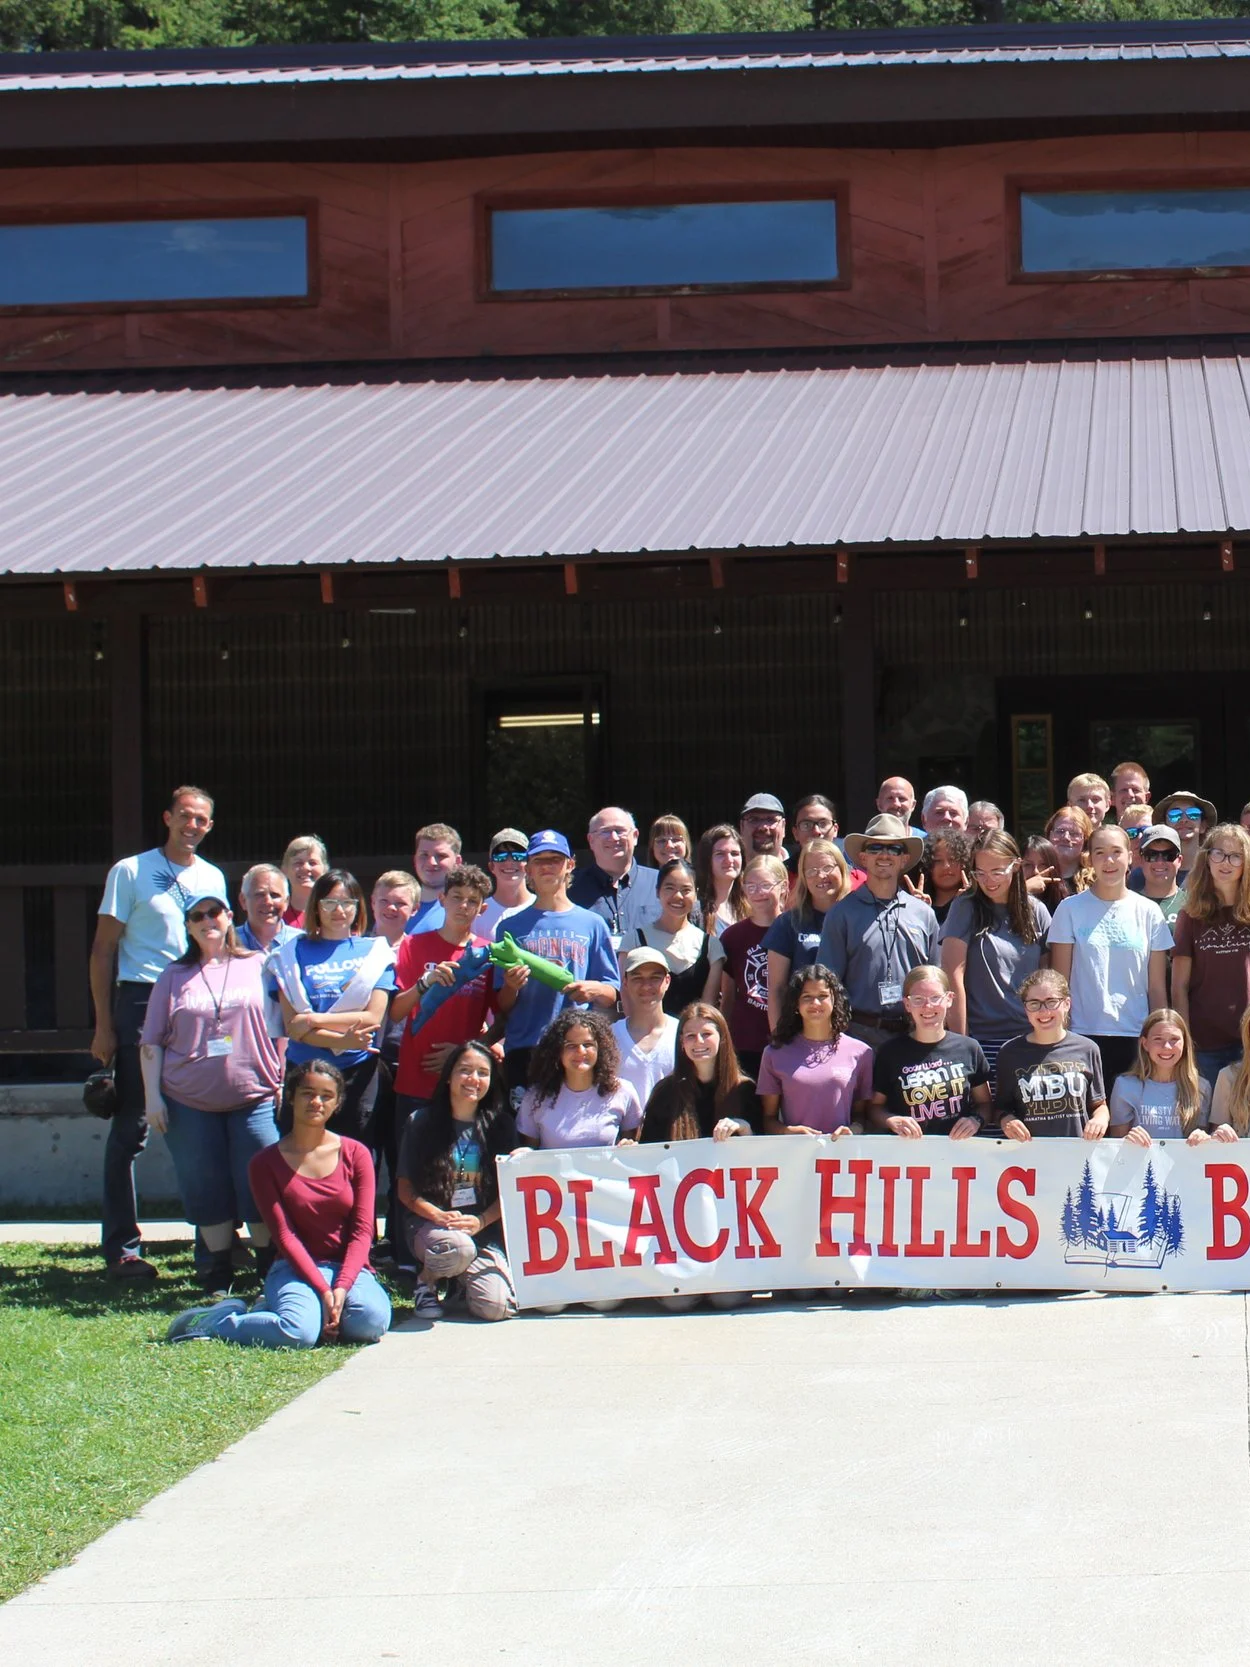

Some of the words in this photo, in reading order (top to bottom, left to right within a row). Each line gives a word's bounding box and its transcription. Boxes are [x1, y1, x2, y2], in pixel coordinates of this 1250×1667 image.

[524, 938, 588, 968] RONCOS
[950, 1063, 965, 1079] IT
[903, 1082, 948, 1106] LOVE
[951, 1077, 965, 1096] IT
[1018, 1072, 1084, 1103] MBU
[911, 1100, 946, 1122] LIVE
[949, 1095, 963, 1114] IT
[1140, 1116, 1163, 1125] LIVING
[518, 1168, 781, 1274] BLACK
[816, 1159, 1039, 1258] HILLS
